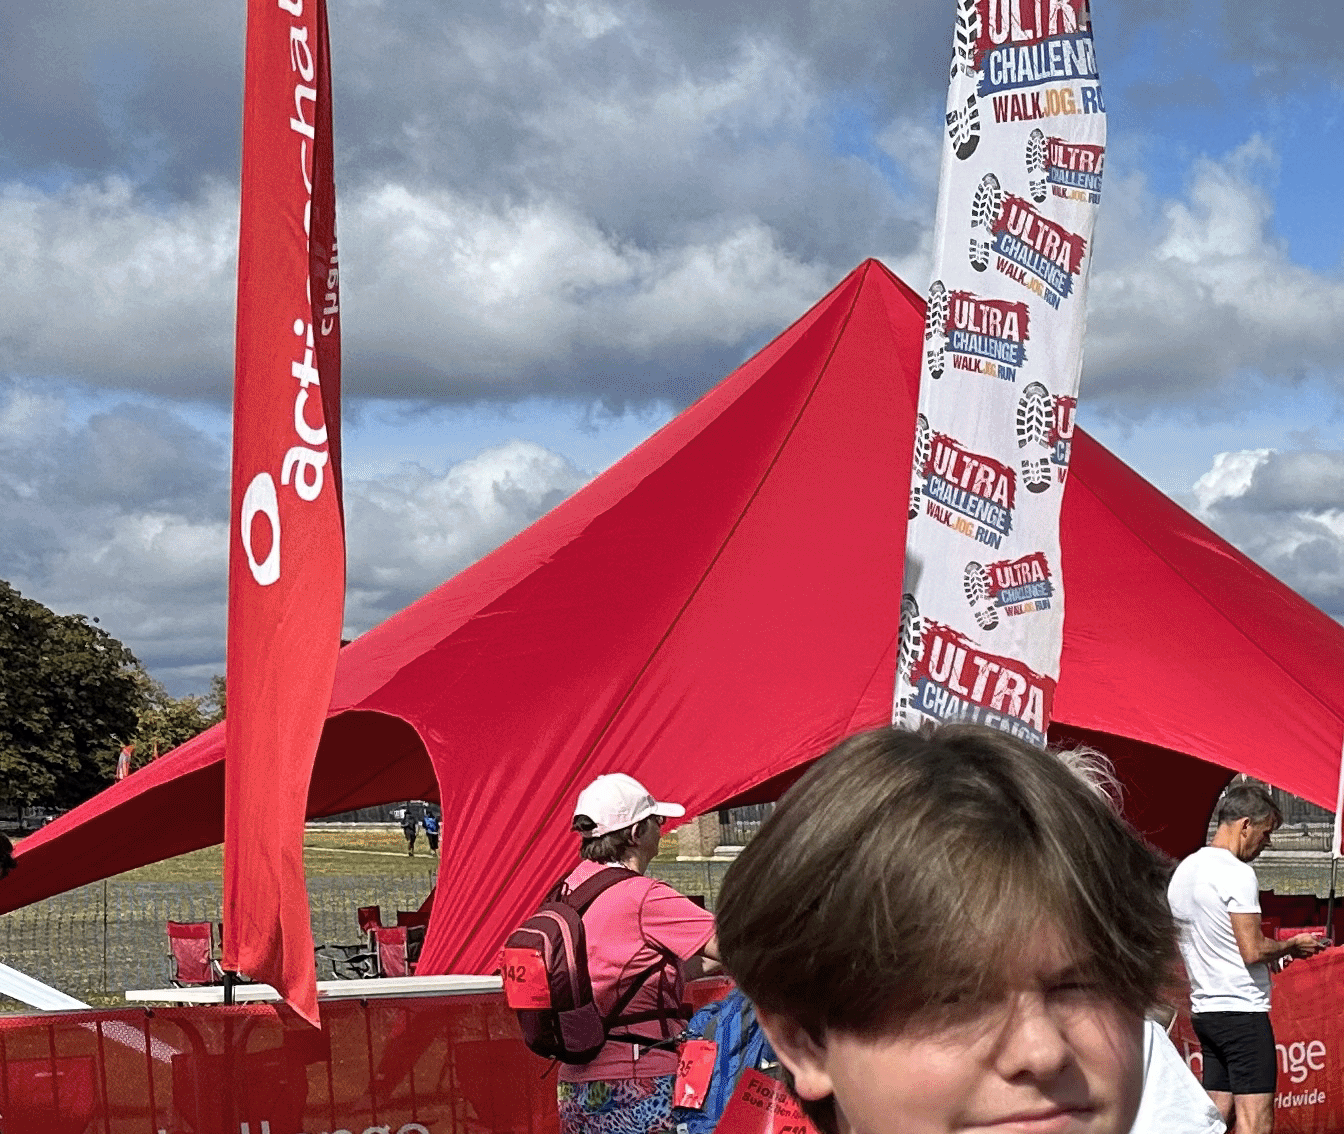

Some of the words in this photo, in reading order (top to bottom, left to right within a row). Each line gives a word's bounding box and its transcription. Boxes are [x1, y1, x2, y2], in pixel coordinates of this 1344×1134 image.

[1000, 234, 1067, 293] CHALLENGE
[1006, 203, 1071, 273] ULTRA
[953, 331, 1019, 363] CHALLENGE
[954, 299, 1020, 342] ULTRA
[929, 475, 1008, 531] CHALLENGE
[933, 442, 1009, 510] ULTRA
[995, 560, 1045, 588] ULTRA
[1001, 582, 1047, 604] CHALLENGE
[929, 635, 1044, 733] ULTRA
